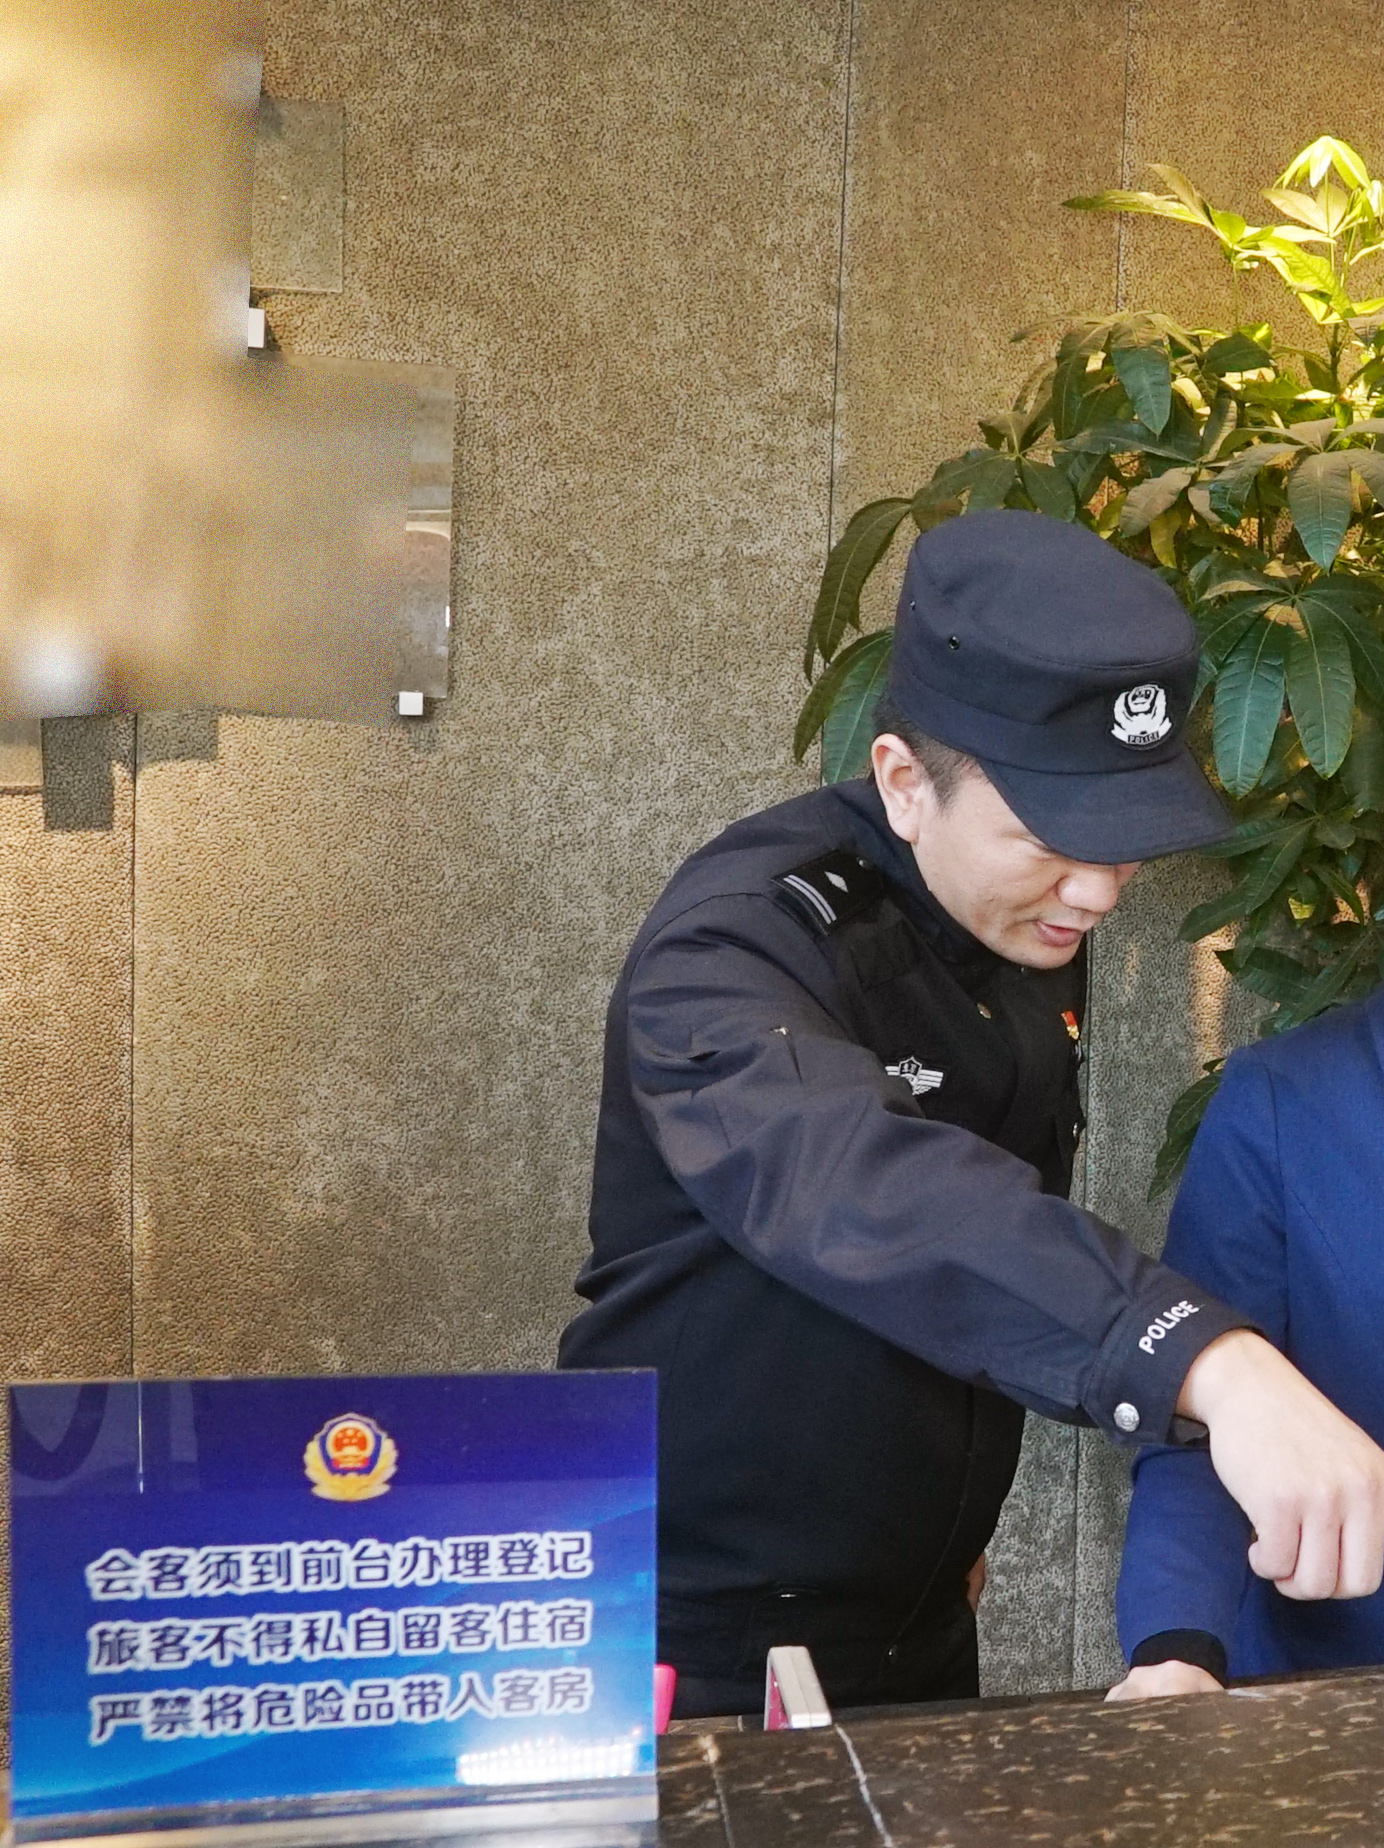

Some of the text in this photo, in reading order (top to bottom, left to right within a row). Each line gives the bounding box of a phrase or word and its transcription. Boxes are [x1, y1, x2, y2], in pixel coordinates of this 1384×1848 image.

[1138, 1300, 1200, 1355] POLICE
[88, 1533, 592, 1599] 会客须到前台办理登记
[88, 1601, 592, 1673] 旅客不得私自留客住宿
